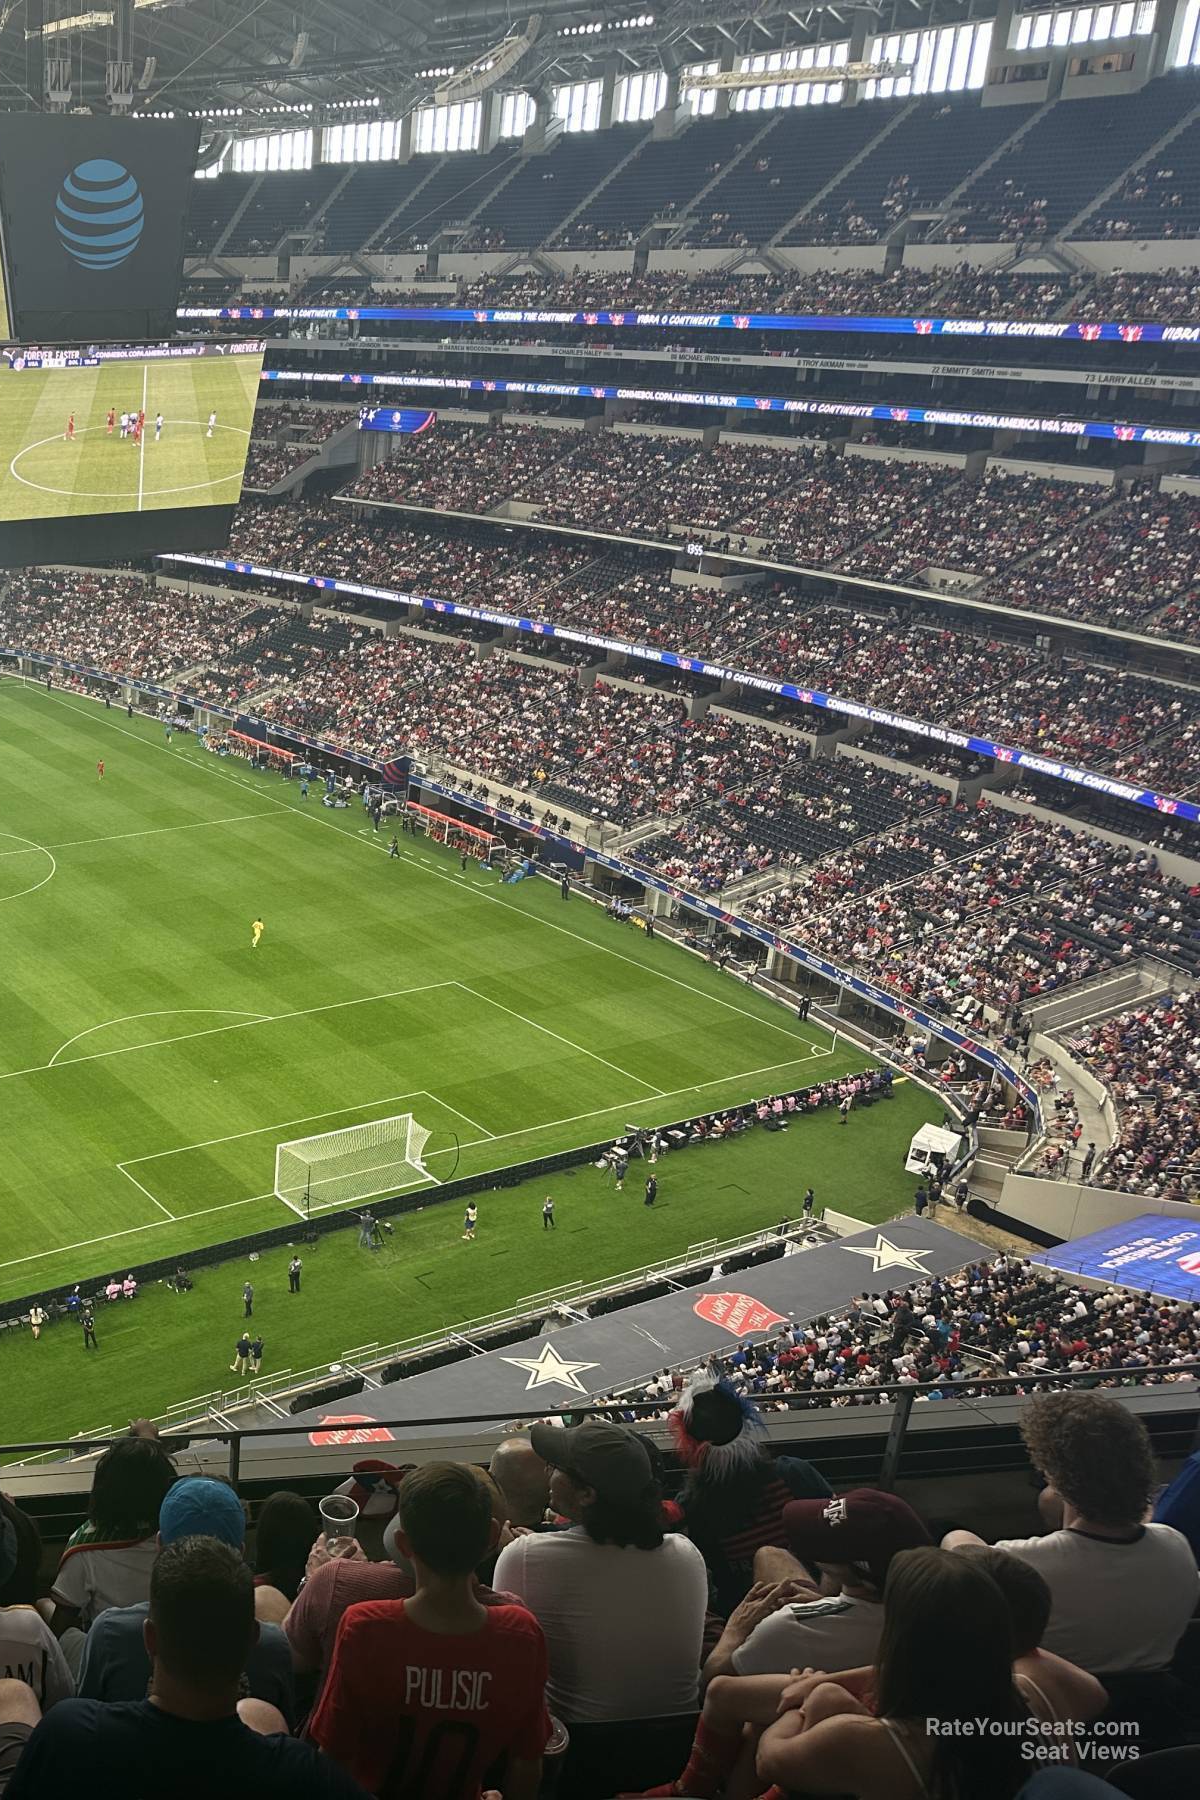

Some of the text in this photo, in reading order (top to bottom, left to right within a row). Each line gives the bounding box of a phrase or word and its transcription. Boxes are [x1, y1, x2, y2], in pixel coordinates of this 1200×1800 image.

[493, 312, 576, 322] ROCKING THE CONTINENT
[637, 315, 721, 326] VIBRA O CONTINENTE
[941, 321, 1069, 336] ROCKING THE CONTINENT
[1162, 328, 1200, 342] VIBRA
[230, 343, 260, 354] FOREVER.
[679, 354, 703, 362] MICHAEL
[819, 361, 844, 369] AIKMAN
[931, 366, 940, 374] 22
[941, 367, 971, 376] EMMITT
[972, 368, 995, 377] SMITH
[373, 375, 403, 384] CONMEBOL
[1085, 374, 1156, 386] 73 LARRY ALLEN
[527, 383, 536, 392] EL
[536, 384, 580, 395] CONTINENTE
[617, 389, 737, 406] CONMEBOL COPA AMERICA USA 2024
[784, 400, 874, 417] VIBRA O CONTINENTE
[924, 411, 1086, 434] CONMEBOL COPA AMERICA USA 2024
[1141, 429, 1191, 443] ROCKING
[702, 664, 784, 694] VIBRA O CONTINENTE
[826, 698, 969, 748] CONMEBOL COPA AMERICA USA 2024
[1018, 753, 1145, 801] ROCKING THE CONTINENT
[709, 1296, 731, 1320] ARMY
[726, 1295, 754, 1331] SALVATION
[748, 1310, 769, 1328] THE
[405, 1665, 493, 1711] PULISIC
